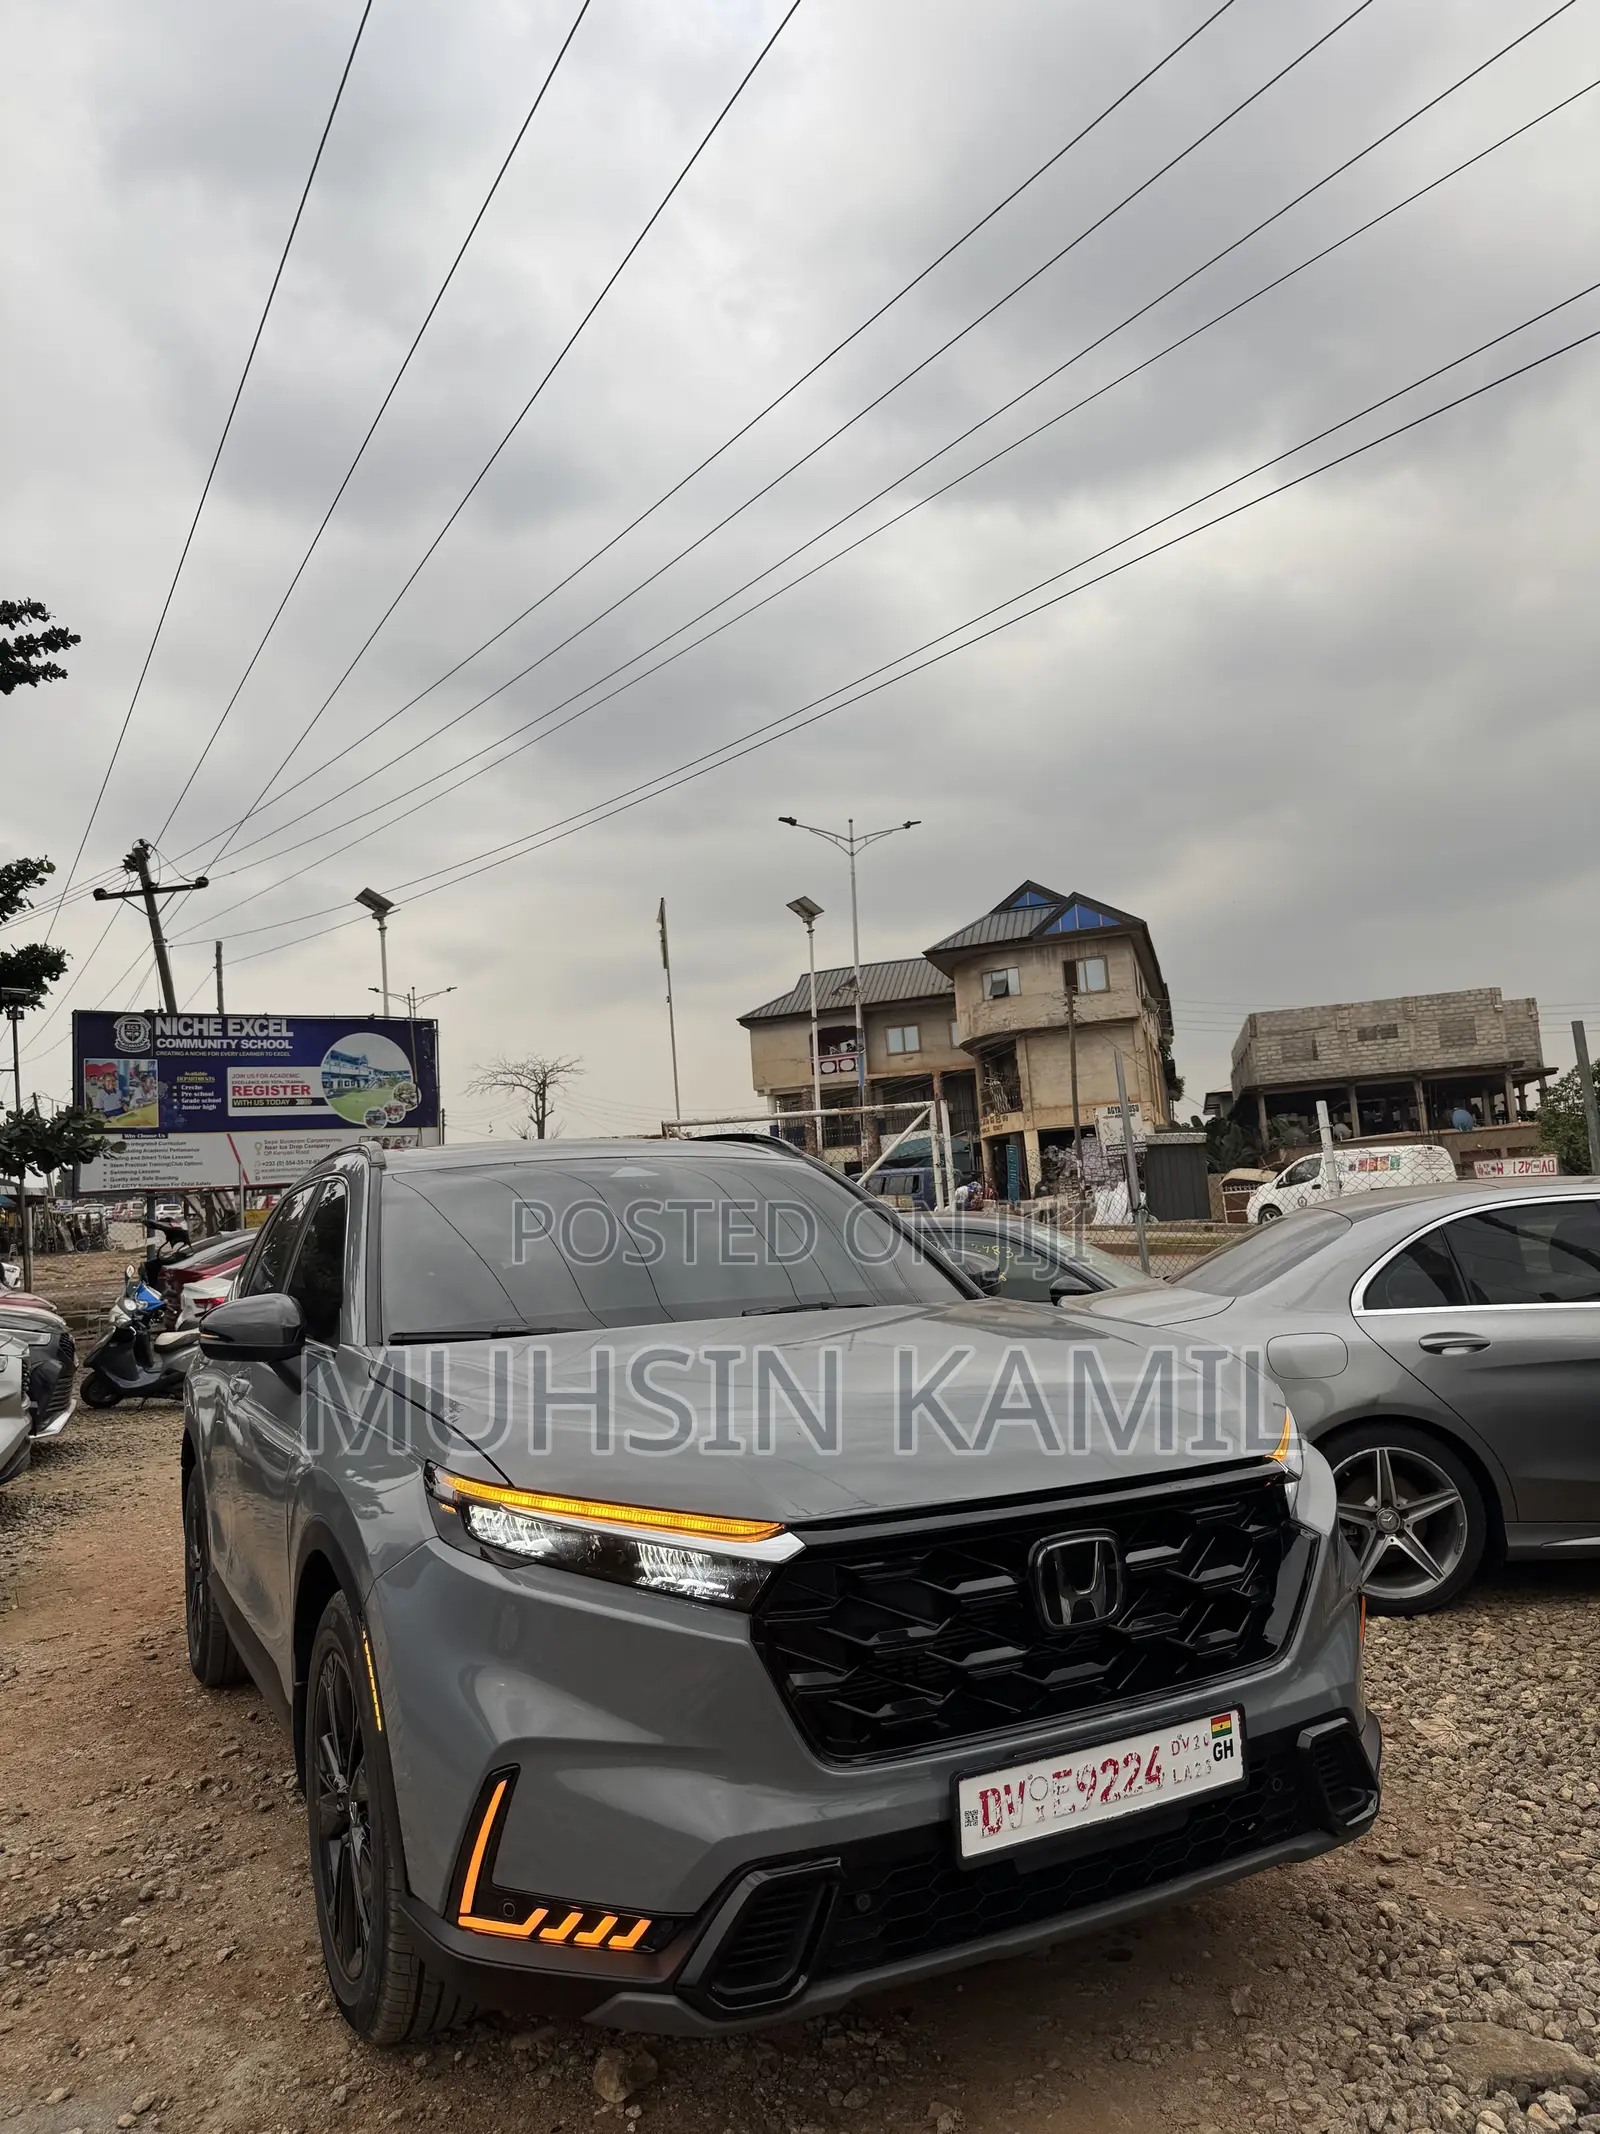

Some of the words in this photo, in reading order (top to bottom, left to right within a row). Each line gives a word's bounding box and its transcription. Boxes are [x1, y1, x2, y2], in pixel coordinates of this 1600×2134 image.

[155, 1016, 223, 1037] NICHE
[227, 1017, 294, 1037] EXCEL
[156, 1038, 238, 1049] COMMUNITY
[240, 1038, 293, 1050] SCHOOL
[232, 1084, 312, 1096] REGISTER
[266, 1098, 291, 1106] TODAY
[1512, 1160, 1532, 1175] 421
[1541, 1159, 1556, 1173] DV
[1213, 1738, 1234, 1762] GH
